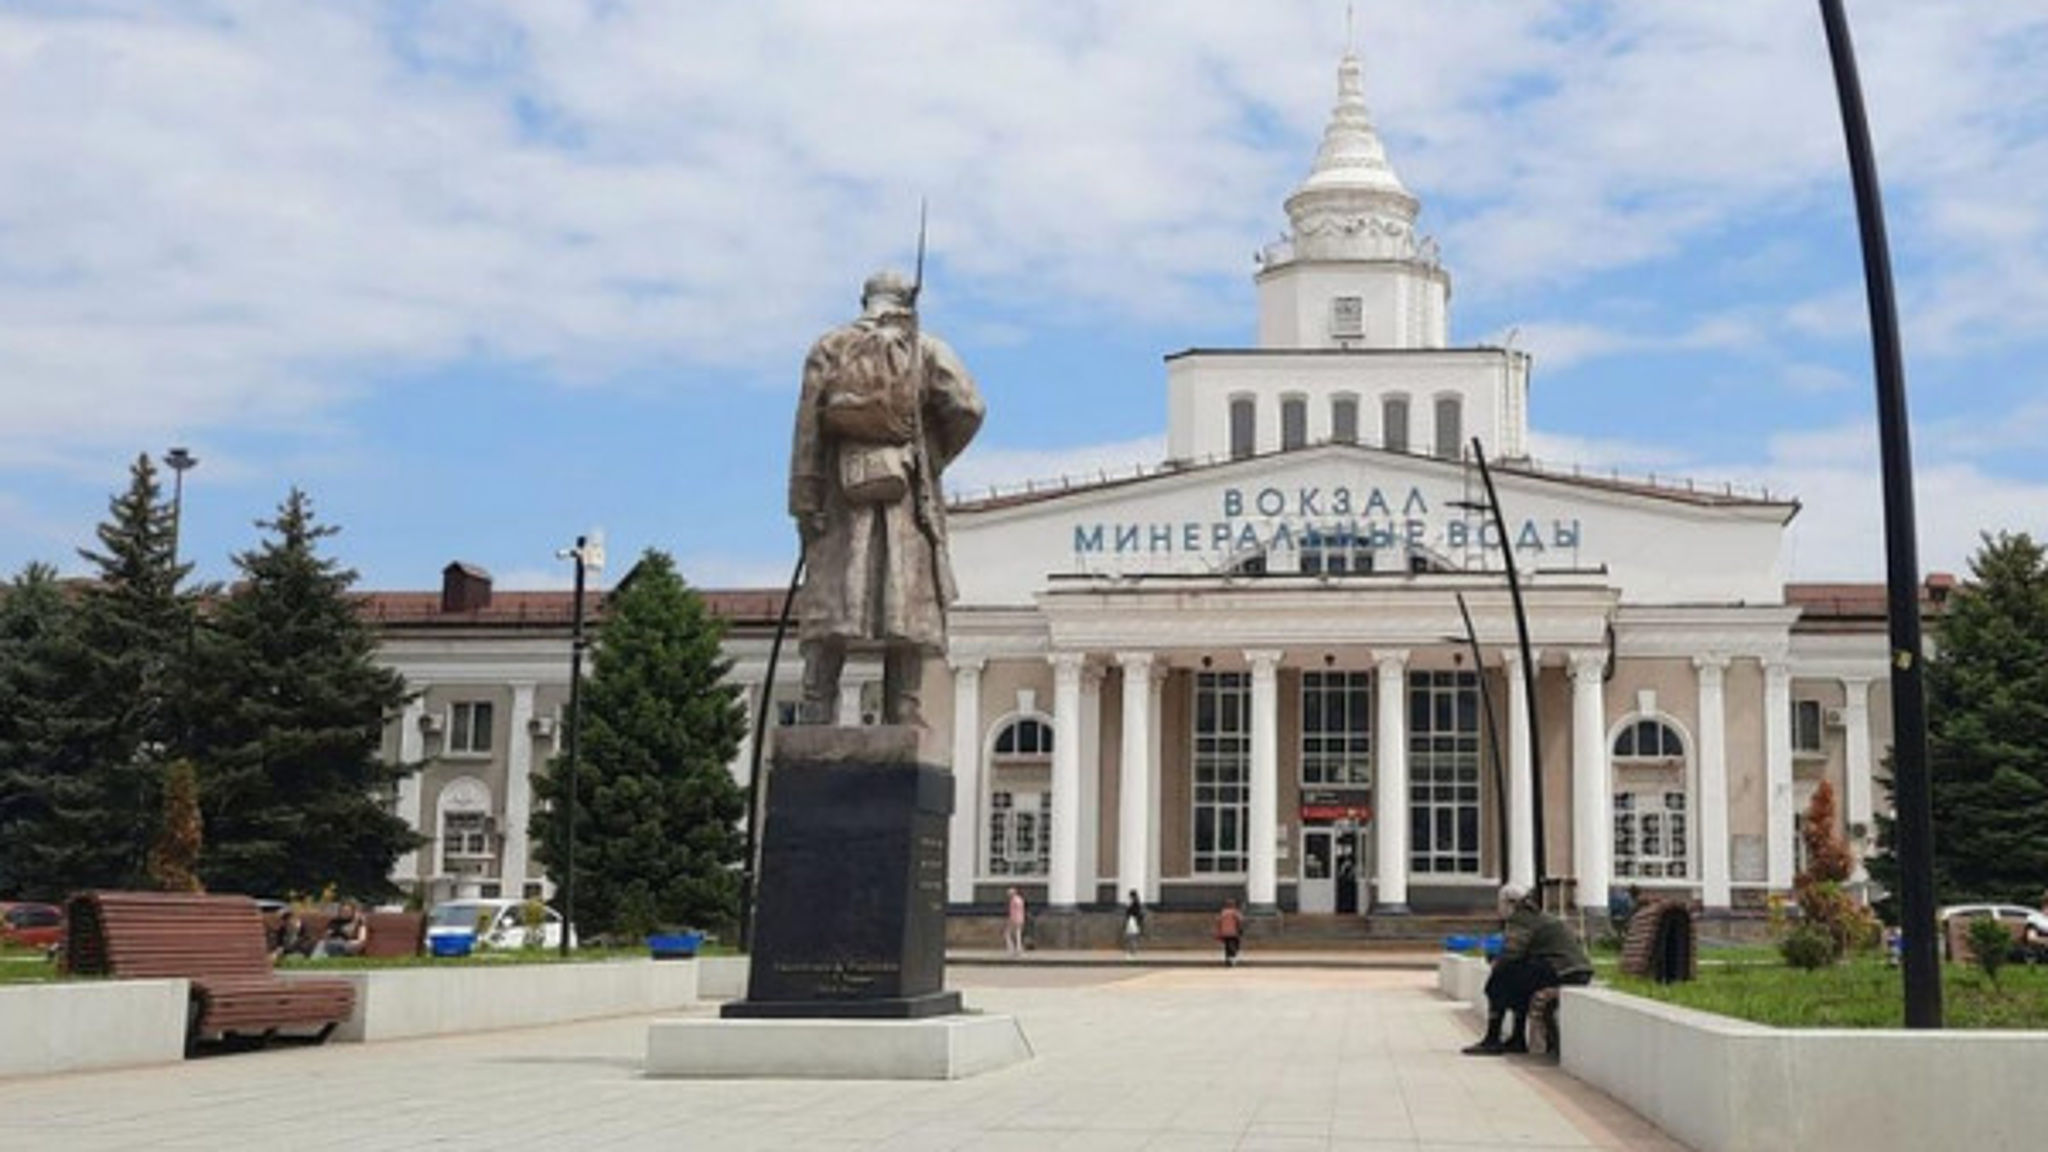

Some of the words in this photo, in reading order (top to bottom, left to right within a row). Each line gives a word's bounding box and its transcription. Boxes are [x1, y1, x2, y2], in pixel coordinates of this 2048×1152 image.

[1225, 487, 1428, 517] ВОКЗАЛ
[1074, 520, 1425, 552] МИНЕРАЛЬНЫЕ
[1448, 519, 1580, 551] ВОДЫ
